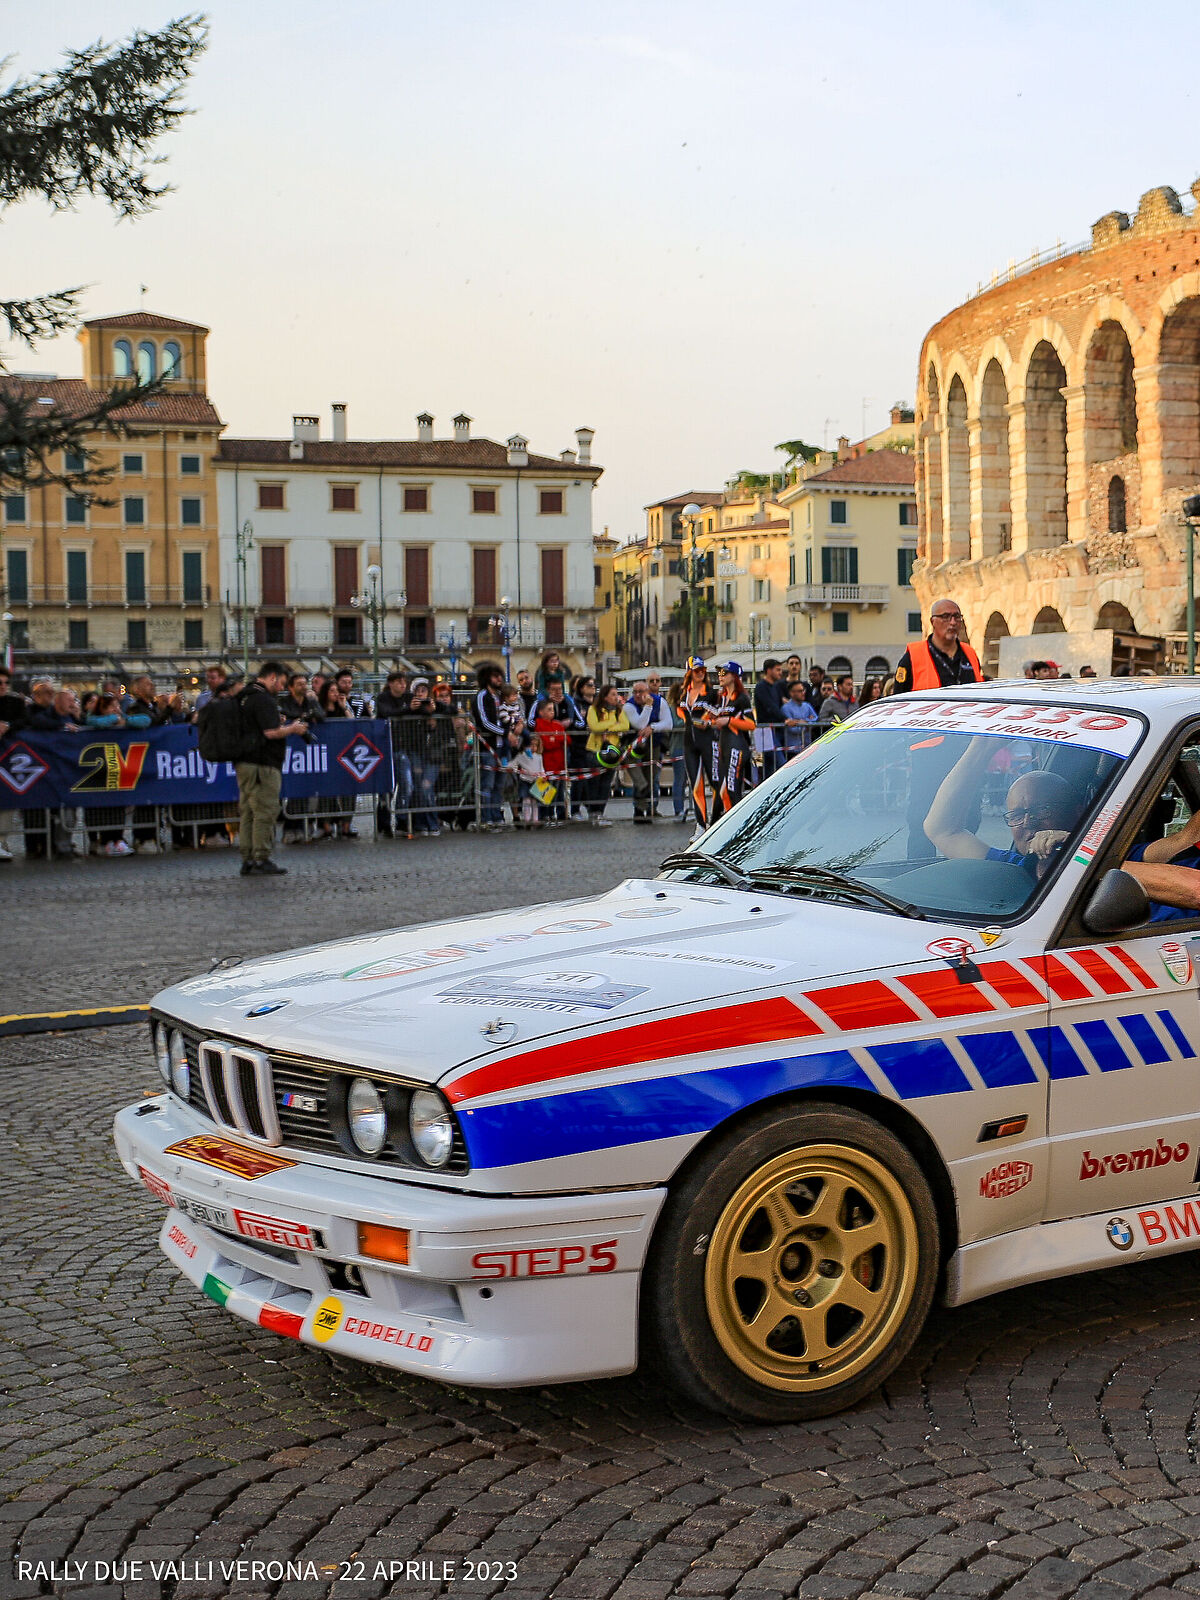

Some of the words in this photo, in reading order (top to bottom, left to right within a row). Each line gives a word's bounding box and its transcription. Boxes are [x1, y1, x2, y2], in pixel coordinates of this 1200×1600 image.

[900, 718, 962, 730] BIBITE
[985, 722, 1080, 741] LIQUORI
[156, 751, 217, 784] Rally
[711, 741, 720, 782] DRIVER
[727, 747, 741, 792] DRIVER
[609, 948, 670, 959] Banca
[545, 973, 595, 983] 311
[439, 996, 584, 1015] CONCORRENTE
[980, 1160, 1034, 1185] MAGNETI
[1079, 1138, 1191, 1181] brembo
[979, 1176, 1033, 1199] MARELLI
[233, 1208, 314, 1252] PIRELLI
[344, 1317, 435, 1353] CARELLO
